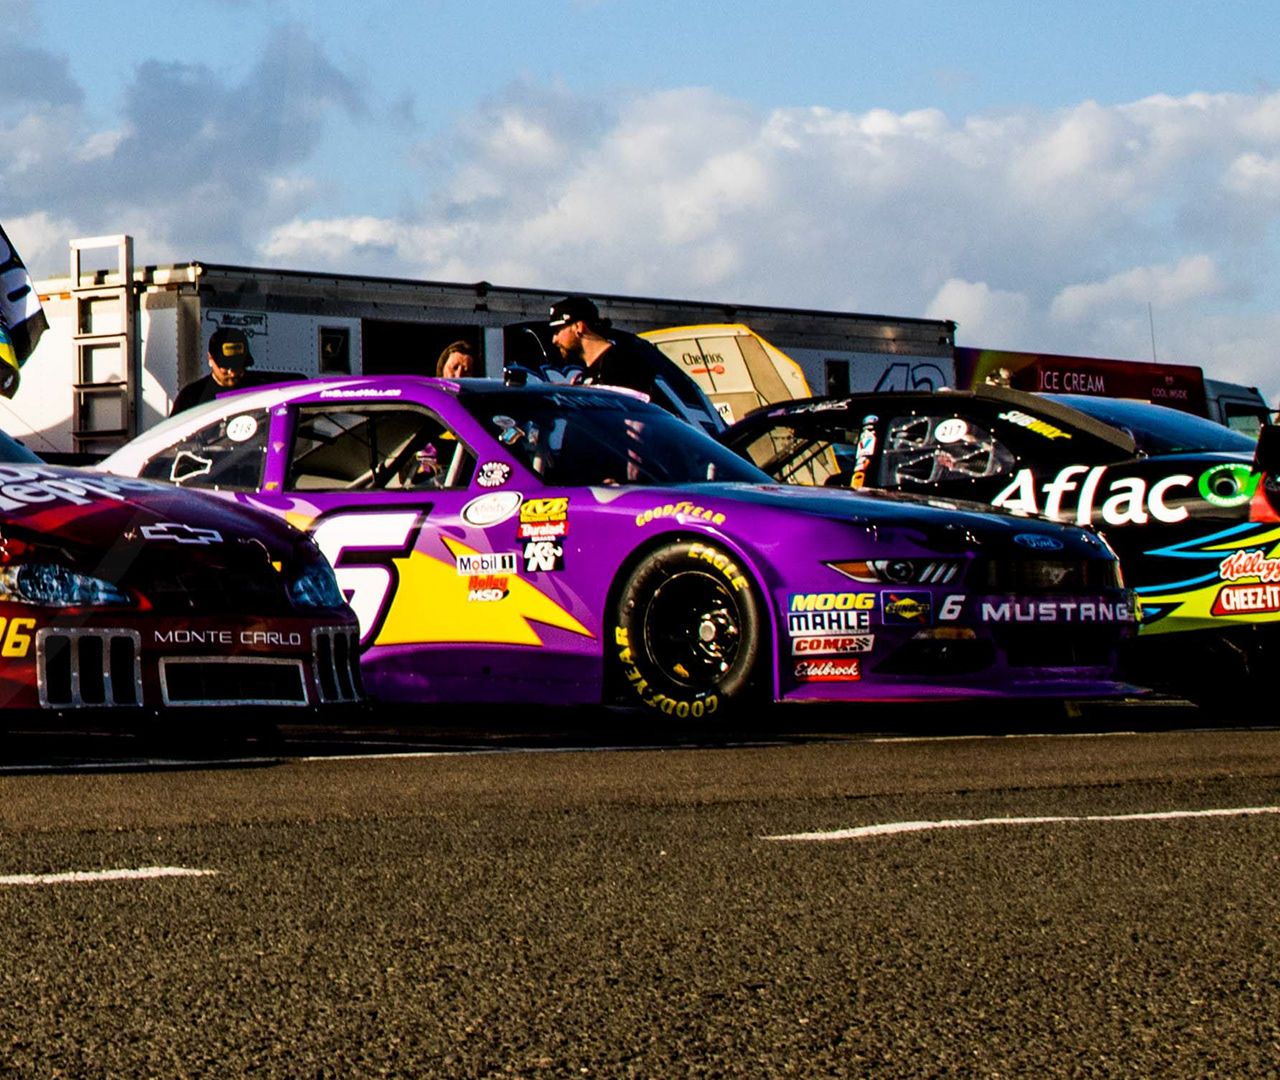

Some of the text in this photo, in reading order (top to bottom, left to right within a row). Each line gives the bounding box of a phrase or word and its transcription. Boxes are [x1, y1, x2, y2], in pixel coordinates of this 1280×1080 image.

[1040, 369, 1106, 393] ICE CREAM
[1151, 387, 1168, 398] COOL
[991, 465, 1194, 527] Aflac
[636, 501, 726, 527] GOODYEAR
[520, 522, 565, 536] Duralast
[460, 555, 497, 571] Mobil
[524, 542, 563, 571] K&N
[687, 542, 750, 592] EAGLE
[468, 574, 509, 592] Holley
[468, 588, 504, 602] MSD
[791, 592, 876, 612] MOOG
[885, 602, 931, 613] SUNOCO
[938, 594, 967, 621] 6
[981, 602, 1128, 621] MUSTANG
[789, 611, 868, 631] MAHLE
[154, 630, 301, 646] MONTE CARLO
[795, 638, 855, 652] COMP
[615, 625, 720, 719] GOODYEAR
[794, 661, 859, 677] Edelbrock
